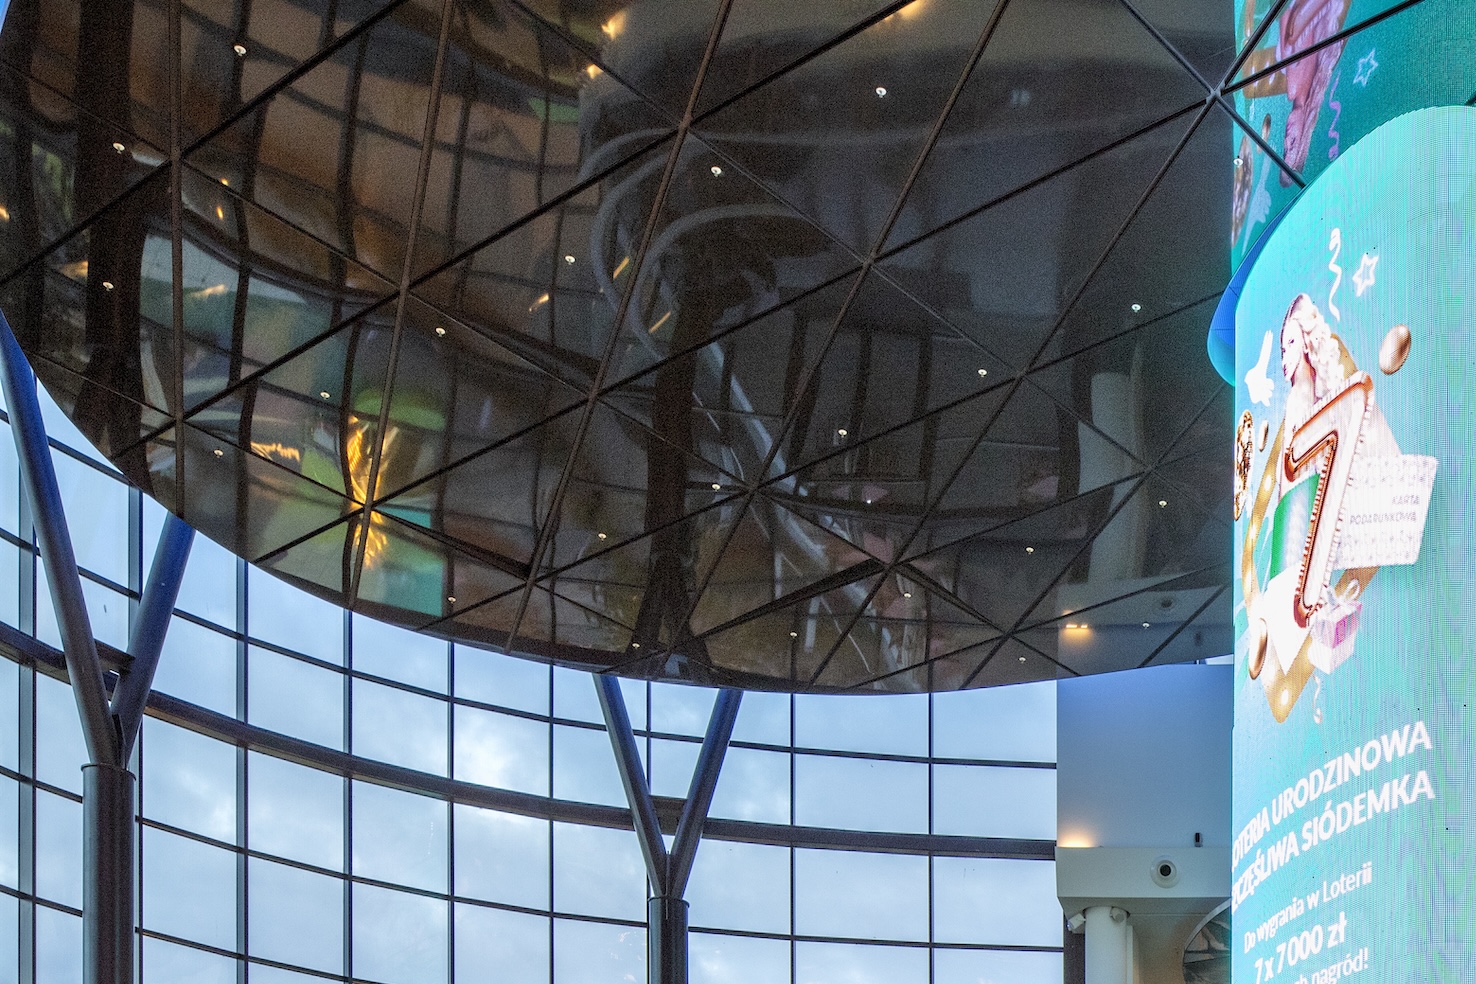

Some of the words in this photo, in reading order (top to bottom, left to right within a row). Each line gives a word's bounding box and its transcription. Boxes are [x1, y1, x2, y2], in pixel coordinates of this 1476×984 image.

[1232, 806, 1271, 873] OTERIA
[1272, 720, 1433, 826] URODZINOWA
[1232, 831, 1300, 916] ZCZĘŚLIWA
[1301, 770, 1436, 852] SIÓDEMKA
[1244, 931, 1256, 954] Do
[1256, 896, 1305, 942] wygrania
[1306, 890, 1320, 910] w
[1322, 861, 1373, 903] Loterii
[1264, 956, 1274, 982] x
[1276, 924, 1324, 975] 7000
[1327, 910, 1347, 949] zł
